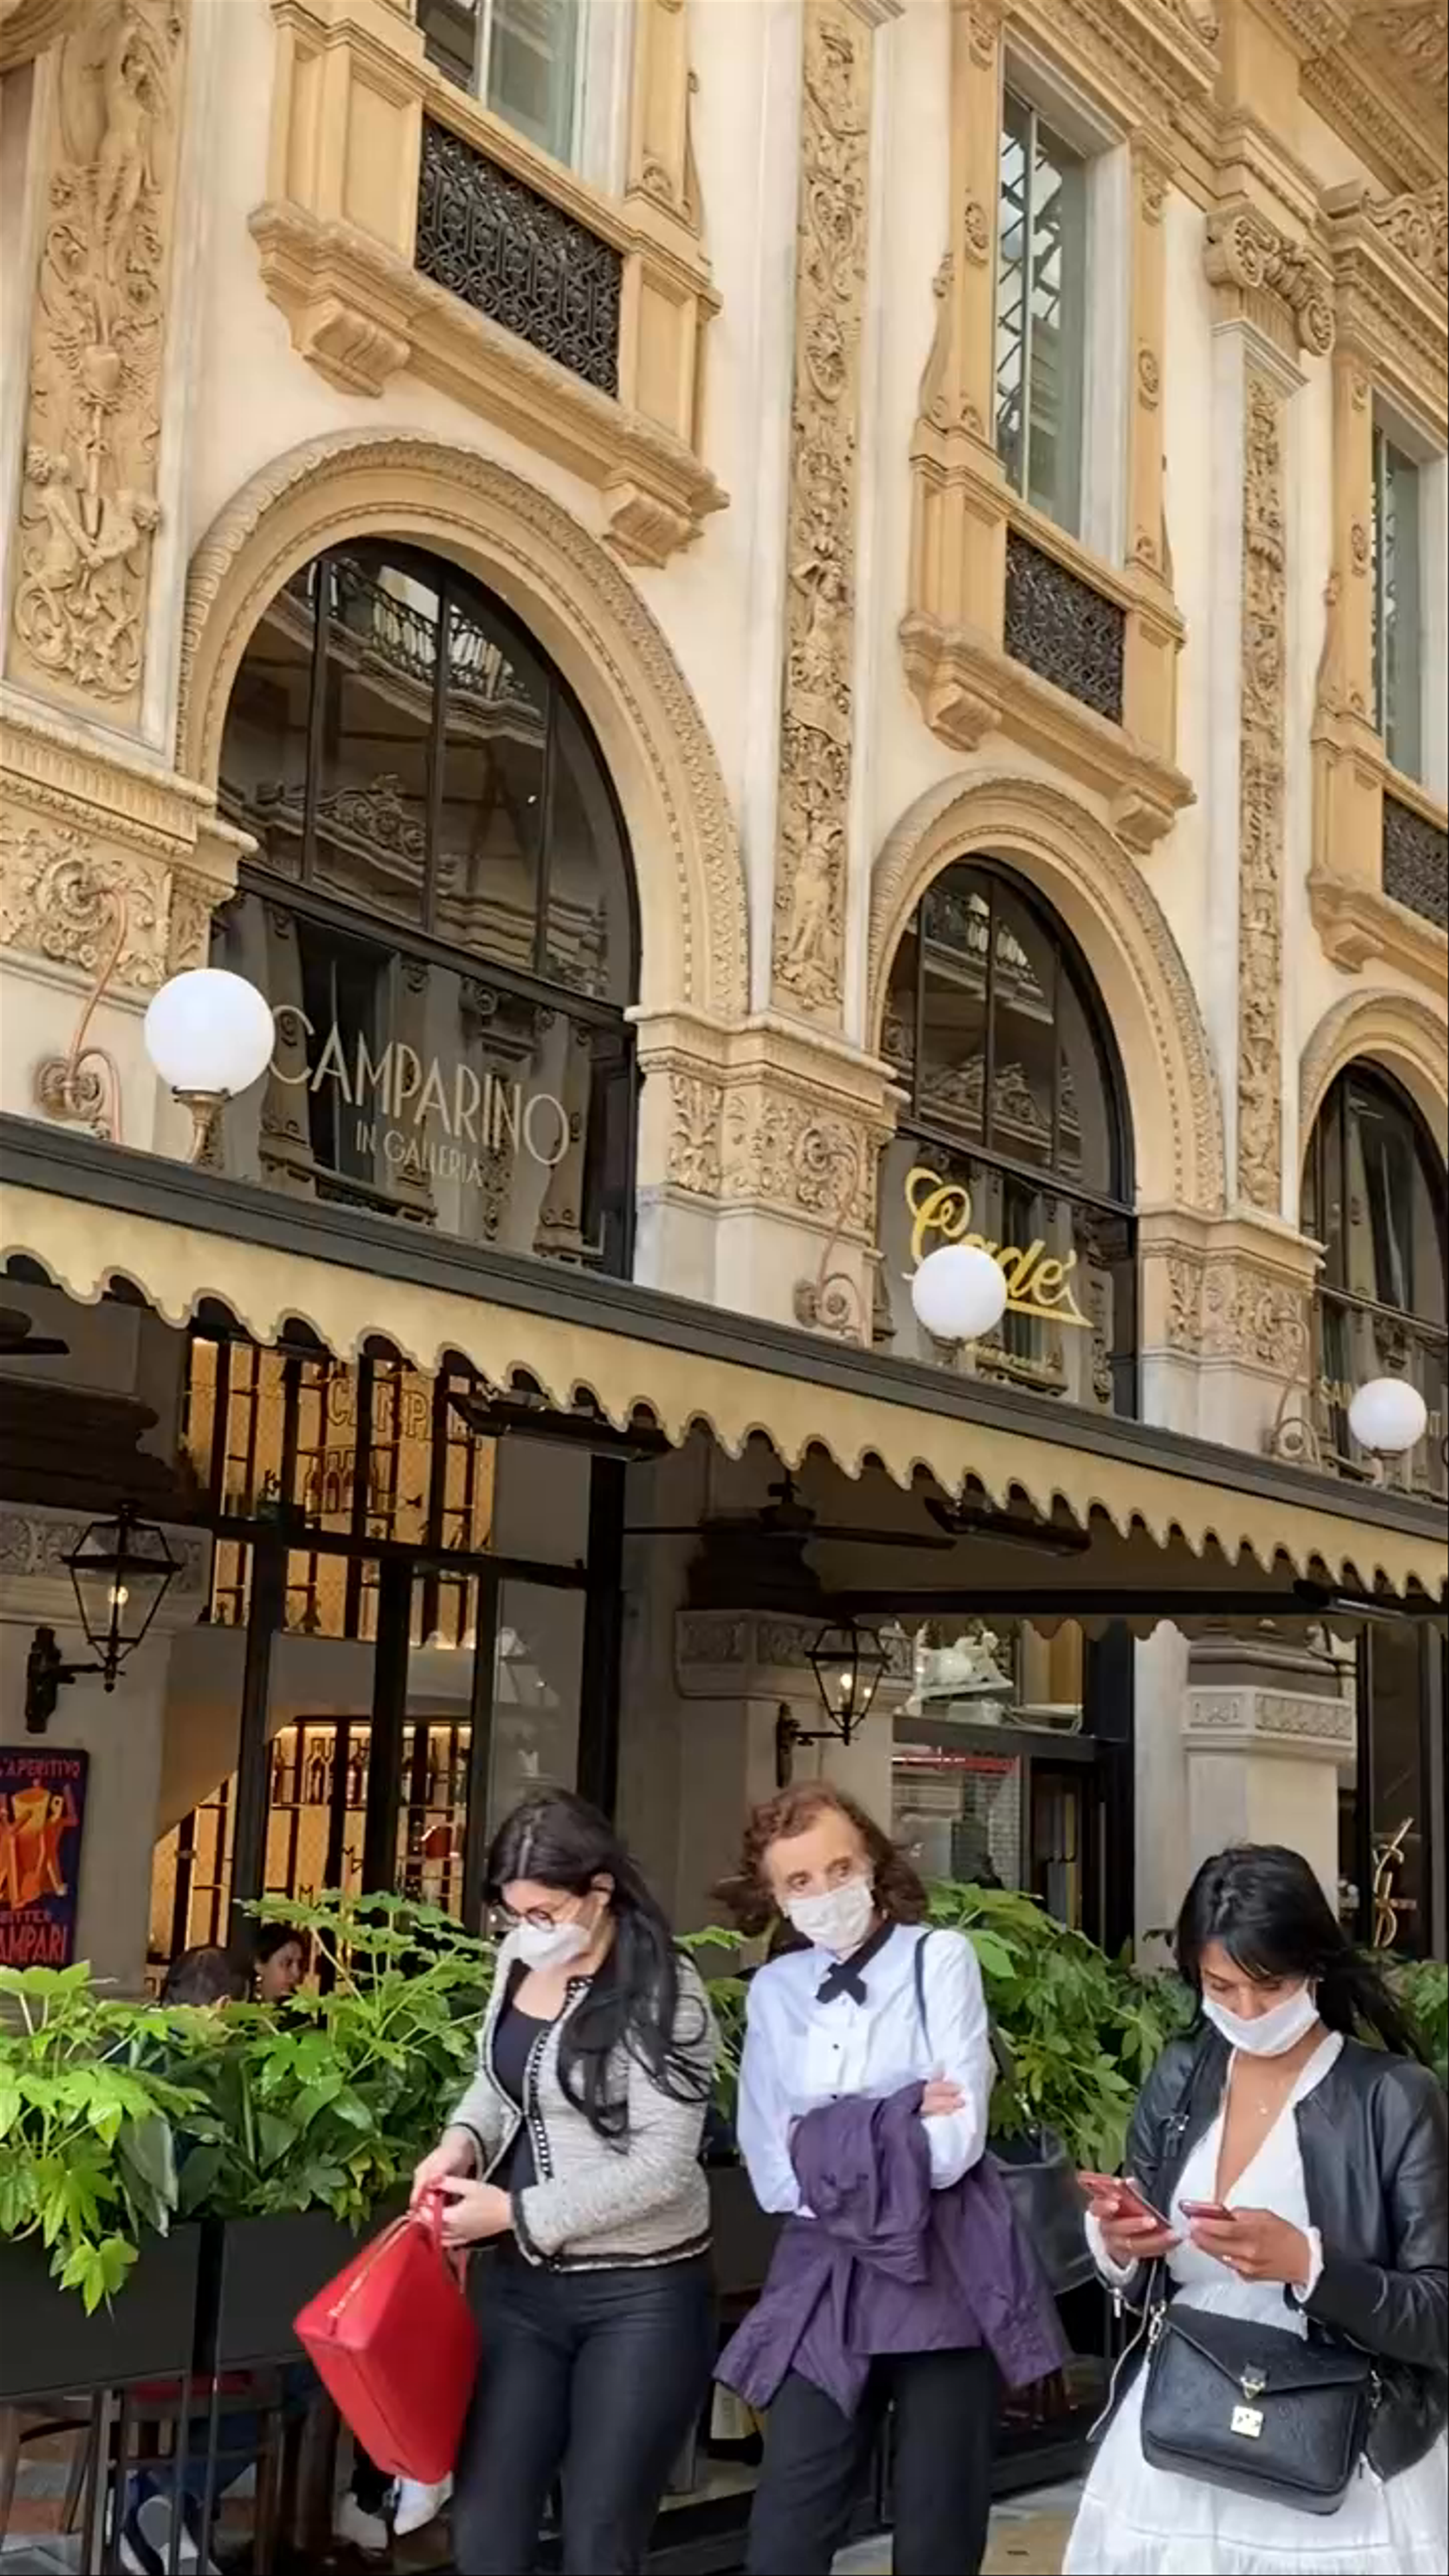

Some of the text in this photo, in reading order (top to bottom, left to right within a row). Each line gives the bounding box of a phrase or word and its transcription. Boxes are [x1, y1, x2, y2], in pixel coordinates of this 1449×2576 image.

[269, 1004, 569, 1165] CAMPARINO
[357, 1120, 483, 1187] IN GALLERIA
